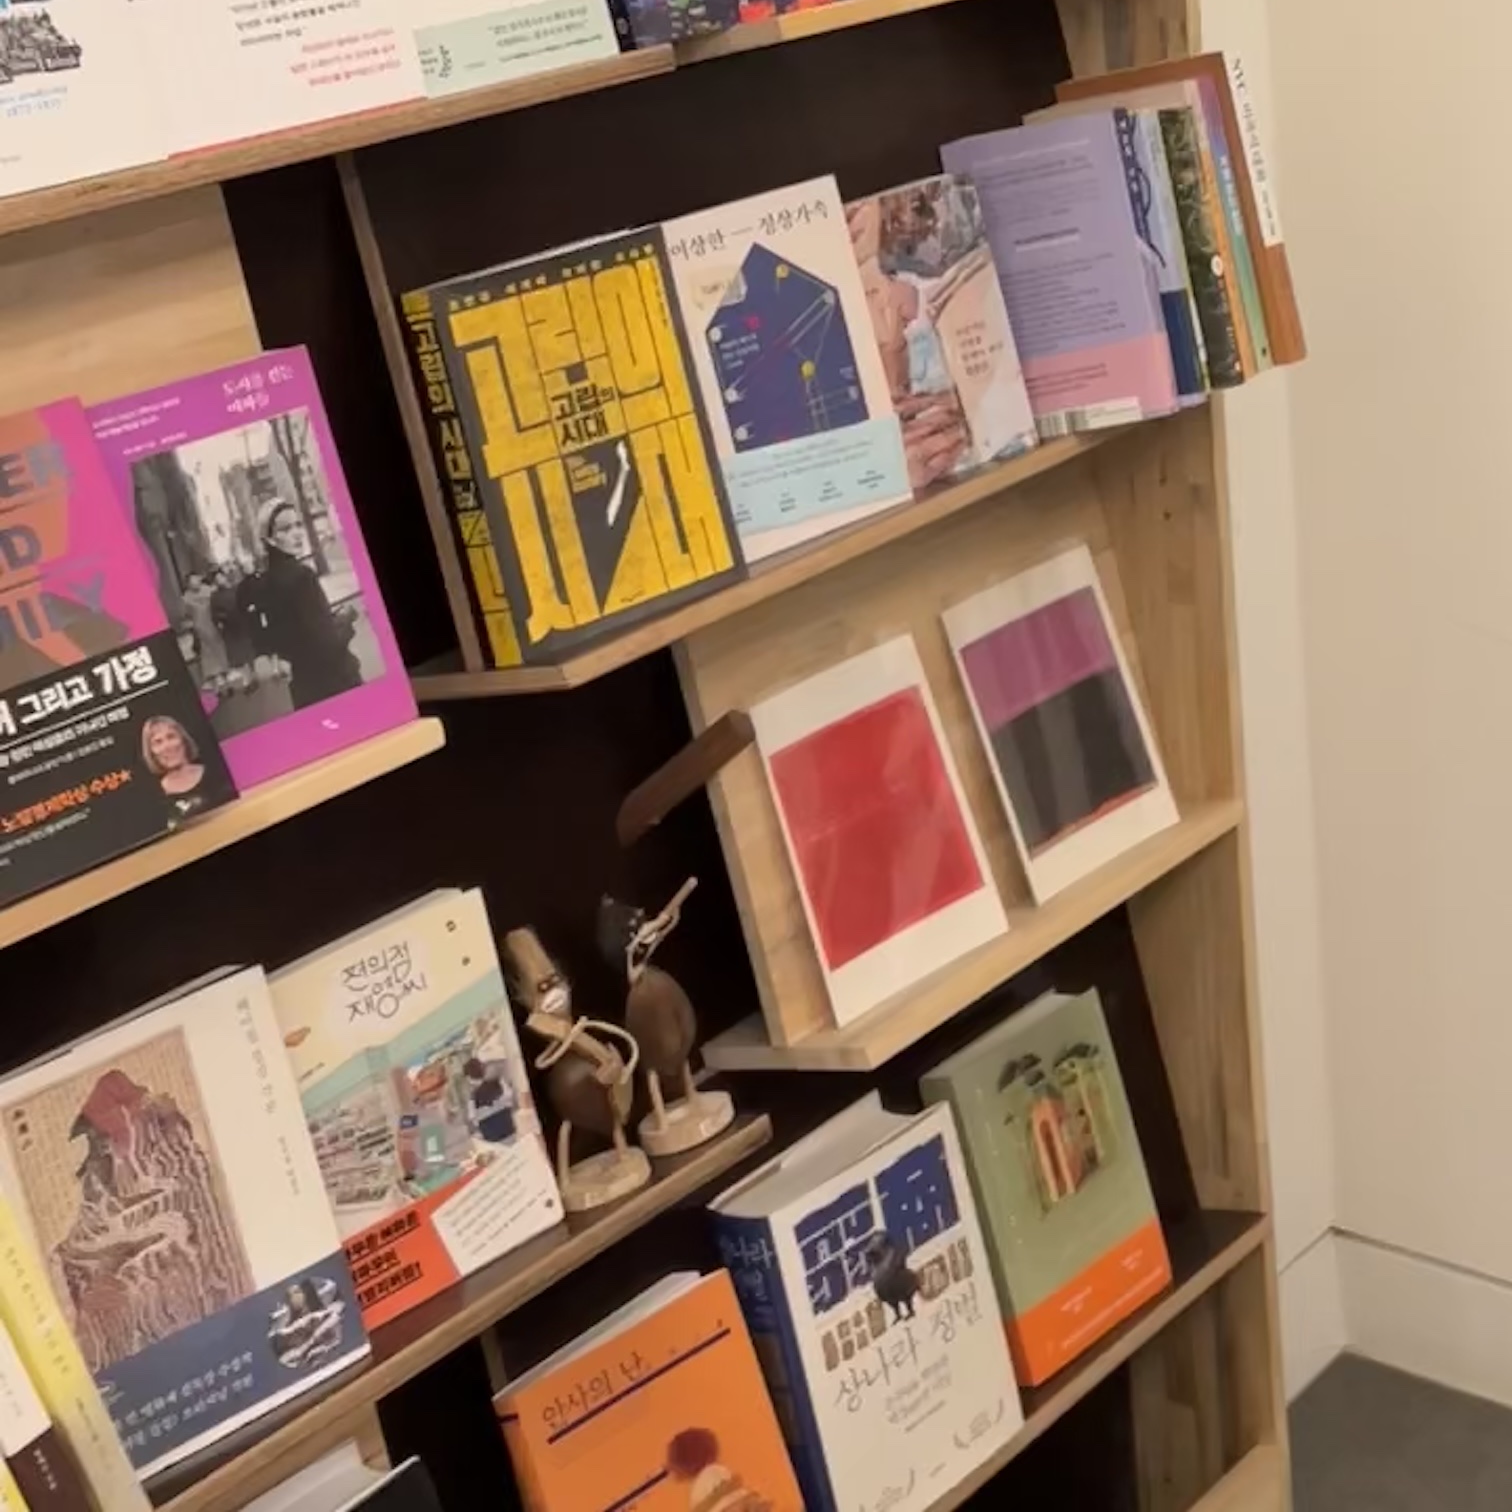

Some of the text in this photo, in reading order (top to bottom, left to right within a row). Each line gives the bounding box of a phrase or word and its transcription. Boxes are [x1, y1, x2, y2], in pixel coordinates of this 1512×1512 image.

[670, 197, 831, 262] 이상한 정상가족
[411, 317, 472, 482] 고립의 시대
[551, 383, 615, 446] 고립의 시대
[17, 674, 93, 725] 그리고
[92, 645, 158, 696] 가정
[833, 1326, 922, 1413] 상나라
[929, 1281, 984, 1343] 정벌
